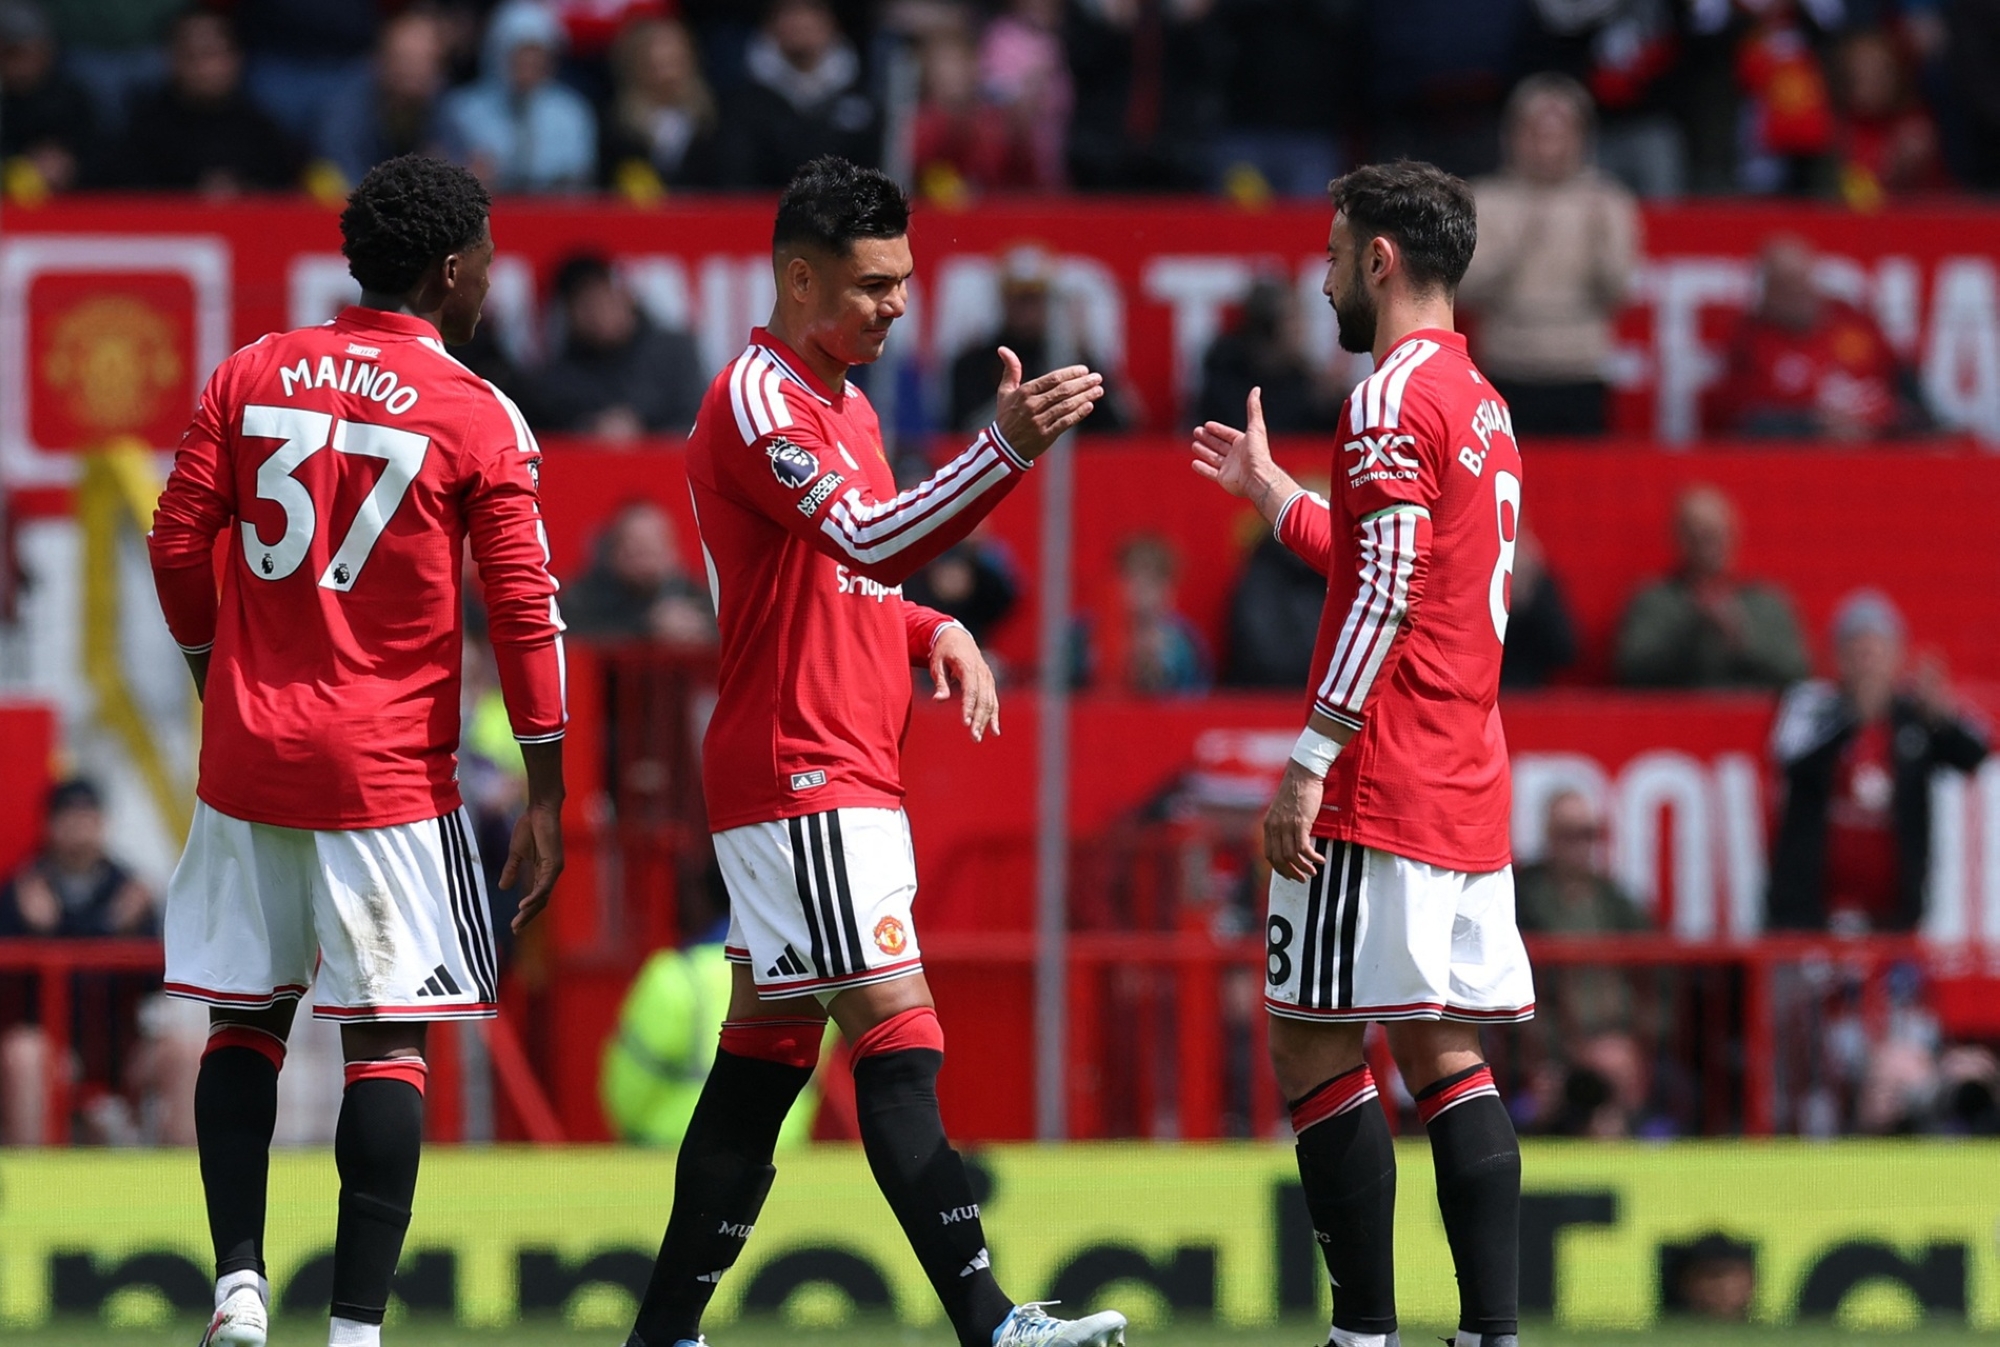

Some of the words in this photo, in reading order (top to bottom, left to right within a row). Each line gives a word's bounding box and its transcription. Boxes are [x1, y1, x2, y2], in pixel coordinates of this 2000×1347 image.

[280, 355, 419, 415] MAINOO
[1344, 433, 1419, 477] DXC
[1350, 471, 1419, 489] TECHNOLOGY
[240, 404, 431, 592] 37
[809, 473, 836, 498] room
[1489, 469, 1521, 646] 8
[1268, 914, 1293, 986] 8
